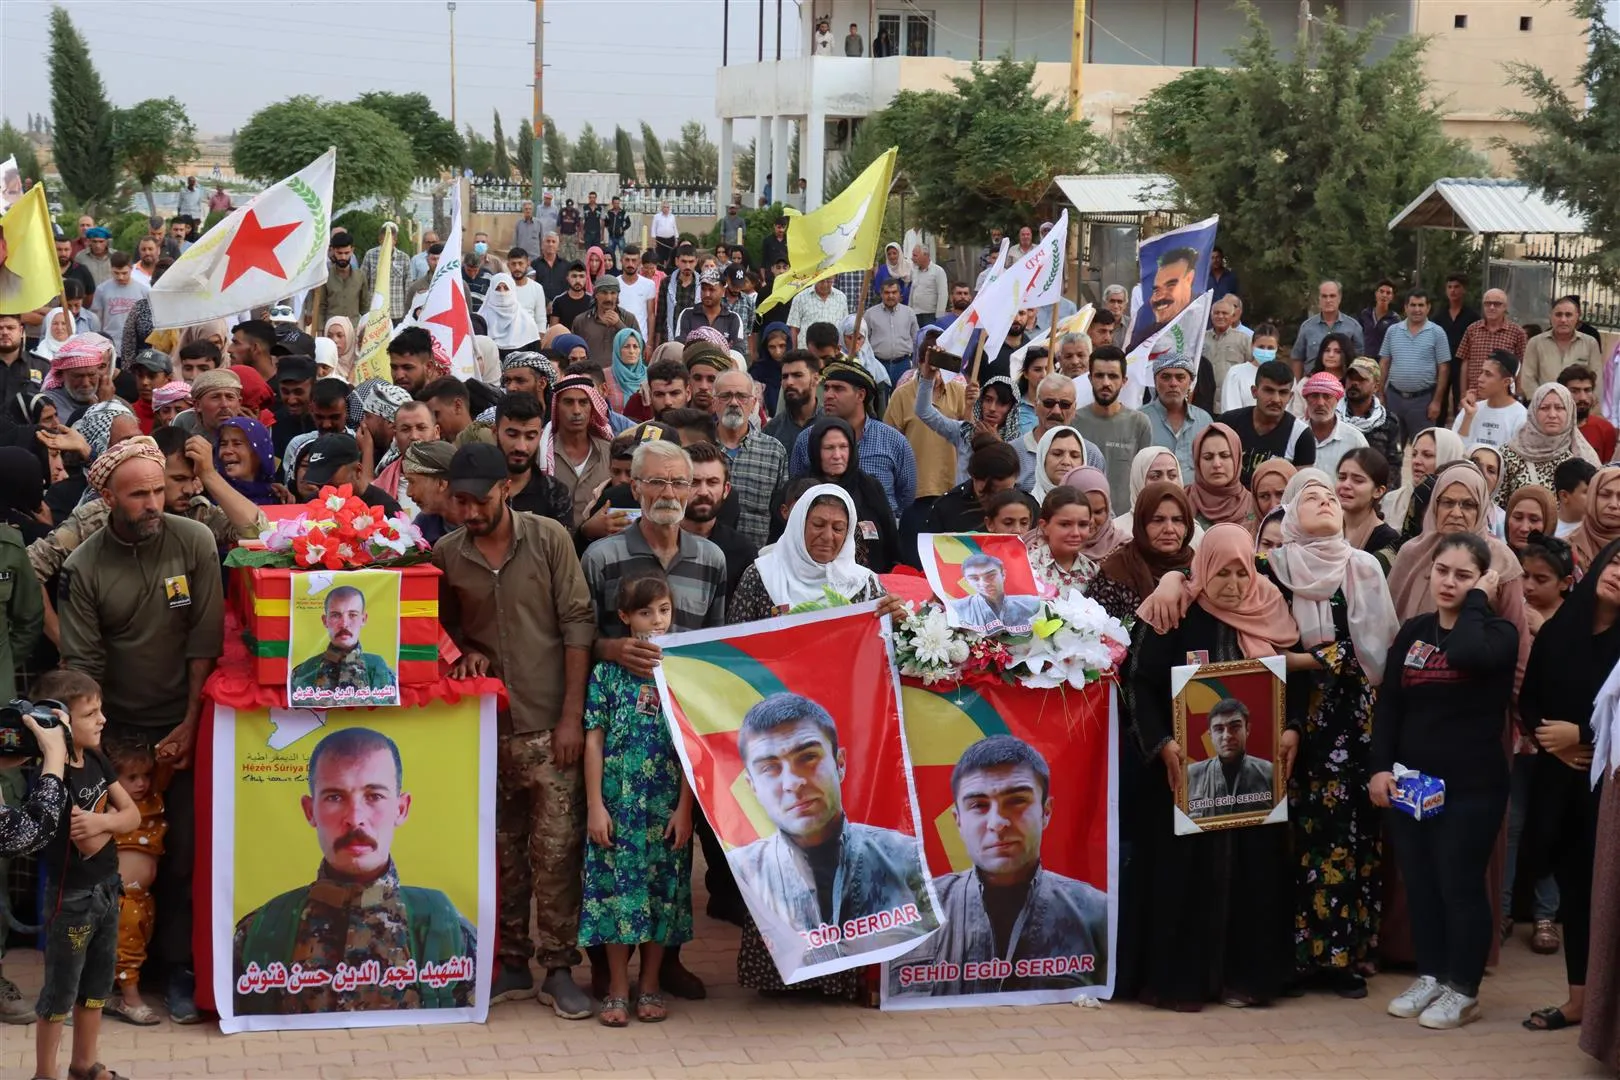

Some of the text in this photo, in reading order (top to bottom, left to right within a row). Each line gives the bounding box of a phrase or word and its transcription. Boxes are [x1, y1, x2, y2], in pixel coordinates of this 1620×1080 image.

[1237, 792, 1272, 804] SERDAR
[844, 904, 921, 939] SERDAR
[288, 964, 331, 992] حسن
[334, 961, 379, 990] الدين
[381, 961, 417, 988] نجم
[420, 957, 472, 986] الشهيد
[900, 956, 1095, 986] ŞEHÎD EGÎD SERDAR
